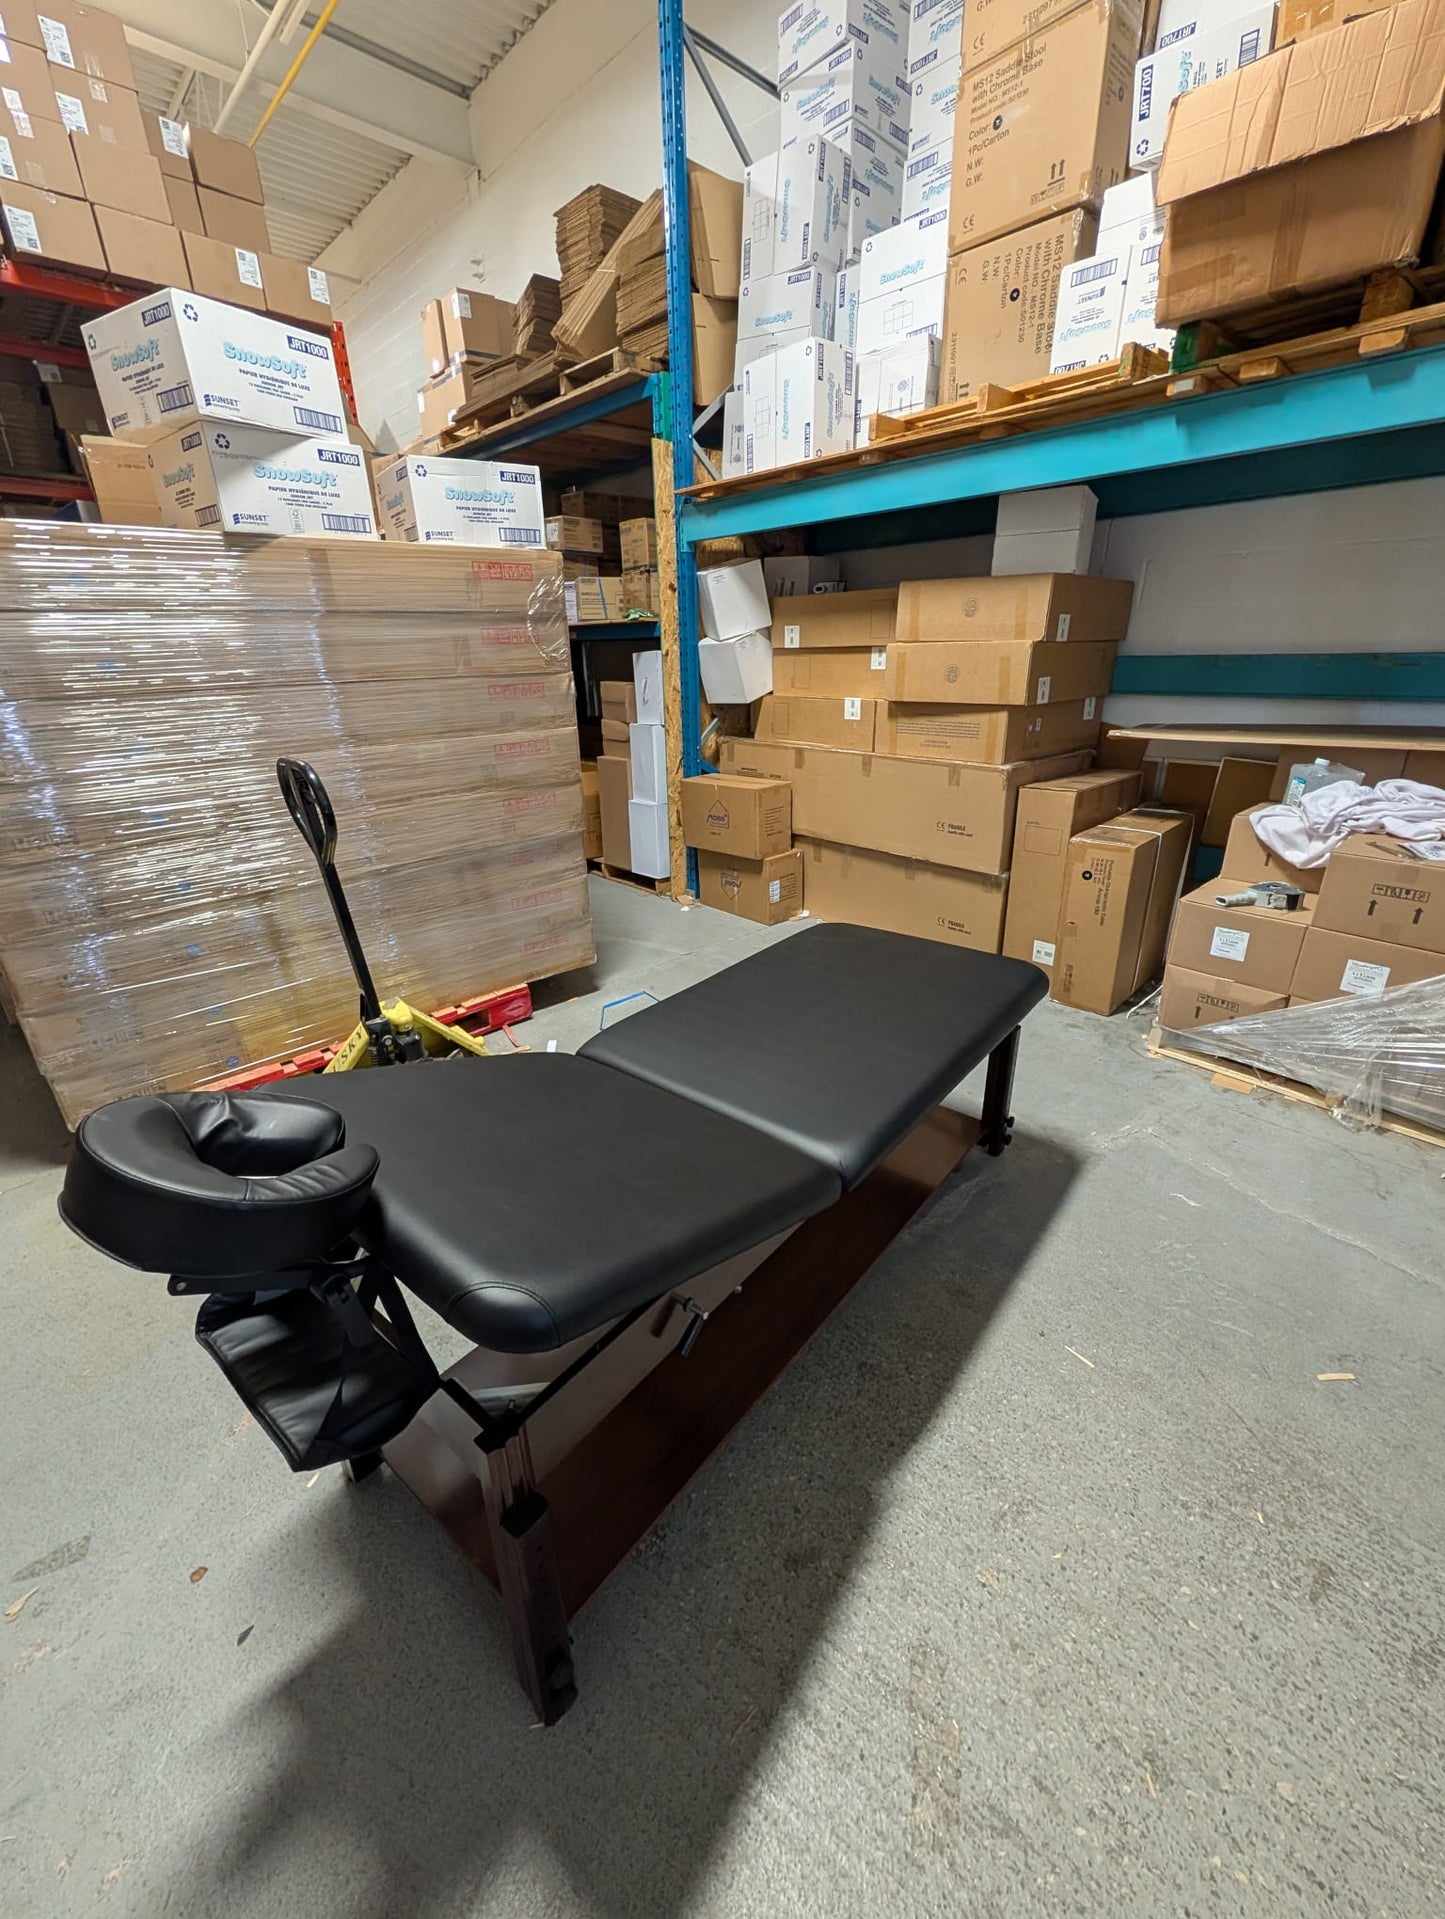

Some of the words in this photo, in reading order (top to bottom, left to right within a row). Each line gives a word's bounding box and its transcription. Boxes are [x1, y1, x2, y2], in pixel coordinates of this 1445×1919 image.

[1160, 22, 1196, 48] JRT700
[971, 87, 988, 104] with
[990, 70, 1021, 94] Chrome
[1022, 58, 1044, 76] Base
[972, 71, 994, 93] MS12
[995, 55, 1024, 80] Saddle
[1024, 43, 1047, 63] Stool
[1139, 65, 1154, 120] JRT700
[968, 122, 991, 141] Color:
[1013, 248, 1024, 280] Color:
[1023, 245, 1033, 282] Product
[1033, 242, 1042, 271] Model
[1042, 239, 1053, 267] with
[1051, 233, 1065, 271] MS12
[787, 271, 812, 285] JRT1000
[879, 258, 927, 285] SnowSoft
[1000, 252, 1012, 309] 1Pc/Carton
[1037, 269, 1050, 320] Chrome
[142, 303, 171, 326] JRT1000
[754, 309, 796, 328] SnowSoft
[1028, 295, 1038, 329] MS12-1
[288, 337, 328, 359] JRT1000
[1034, 323, 1045, 355] Base
[1044, 322, 1056, 354] Stool
[111, 338, 160, 371] SnowSoft
[222, 341, 309, 379] SnowSoft
[211, 394, 240, 407] SUNSET
[319, 450, 359, 465] JRT1000
[253, 463, 337, 488] SnowSoft
[501, 472, 535, 484] JRT1000
[445, 487, 515, 505] SnowSoft
[240, 513, 268, 522] SUNSET
